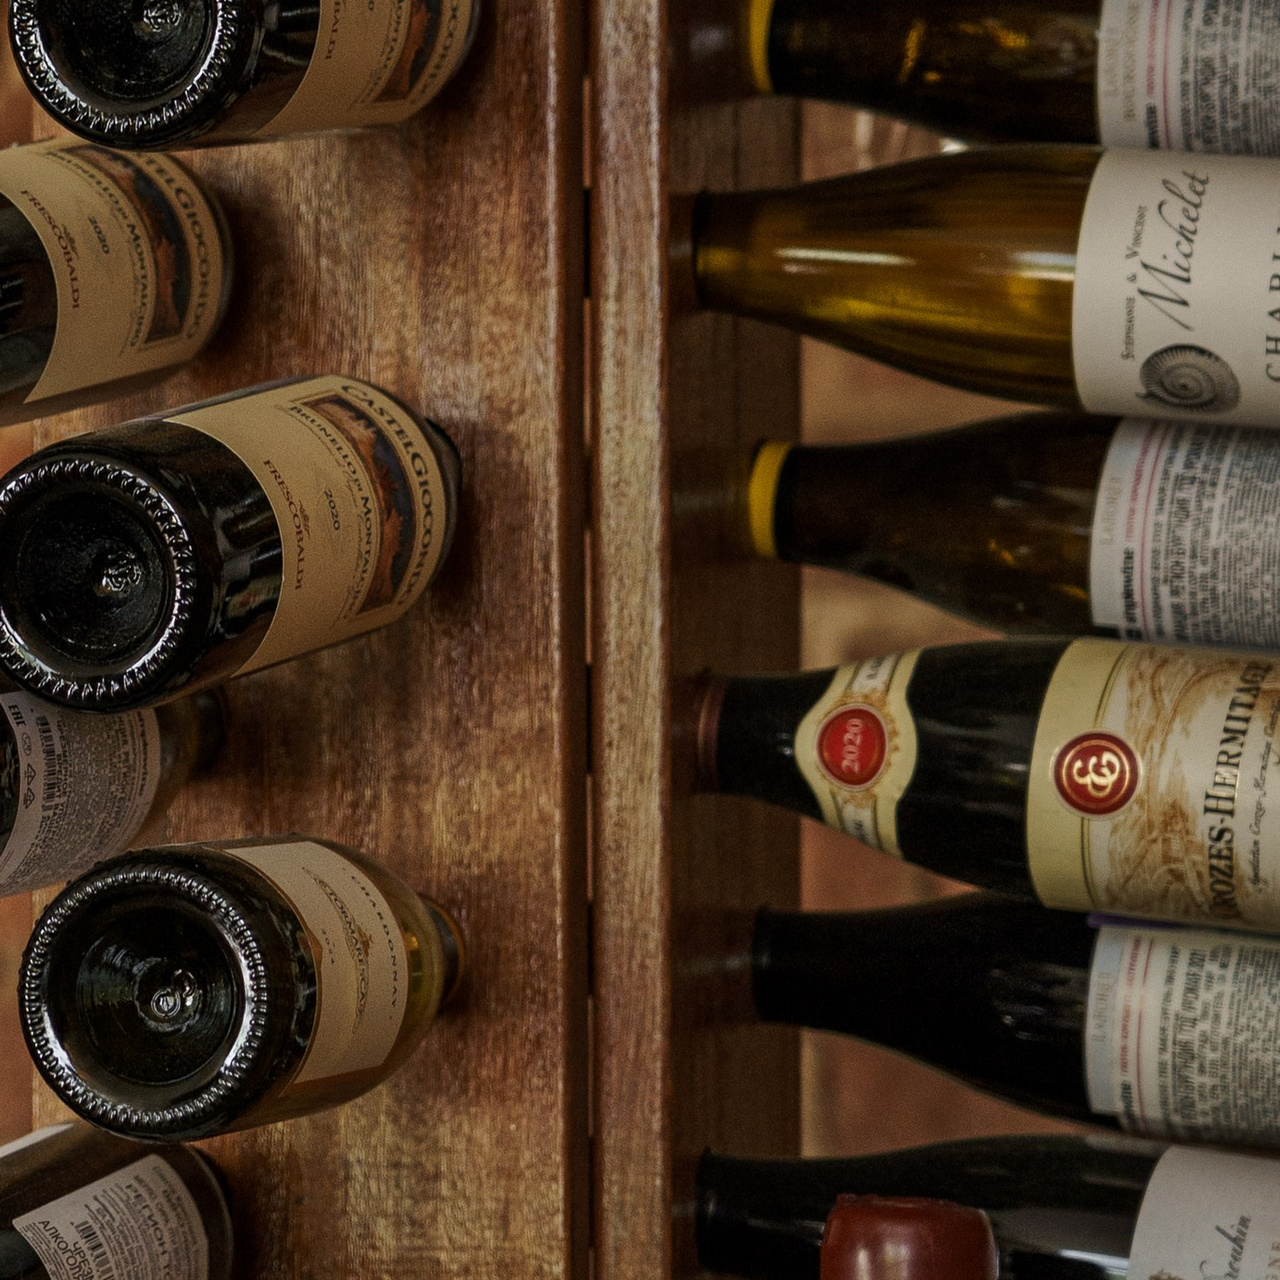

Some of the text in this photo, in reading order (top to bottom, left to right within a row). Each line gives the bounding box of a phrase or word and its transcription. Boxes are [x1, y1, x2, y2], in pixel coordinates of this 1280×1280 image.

[19, 189, 80, 310] FRESCOBALDI
[87, 215, 110, 255] 2020
[1136, 168, 1211, 331] Michelet
[261, 458, 304, 591] FRESCOBALDI
[288, 403, 358, 476] BRUNELLO
[342, 494, 373, 619] MONTALCINO
[323, 488, 342, 532] 2020
[341, 383, 430, 604] CASTELGIOCONDO
[841, 717, 865, 773] 2020
[1202, 661, 1272, 914] CROZES-HERMITAGE
[327, 890, 365, 1007] TORMARESCA
[351, 875, 396, 1007] CHARDONNAY
[123, 1182, 169, 1256] РЕГИОН
